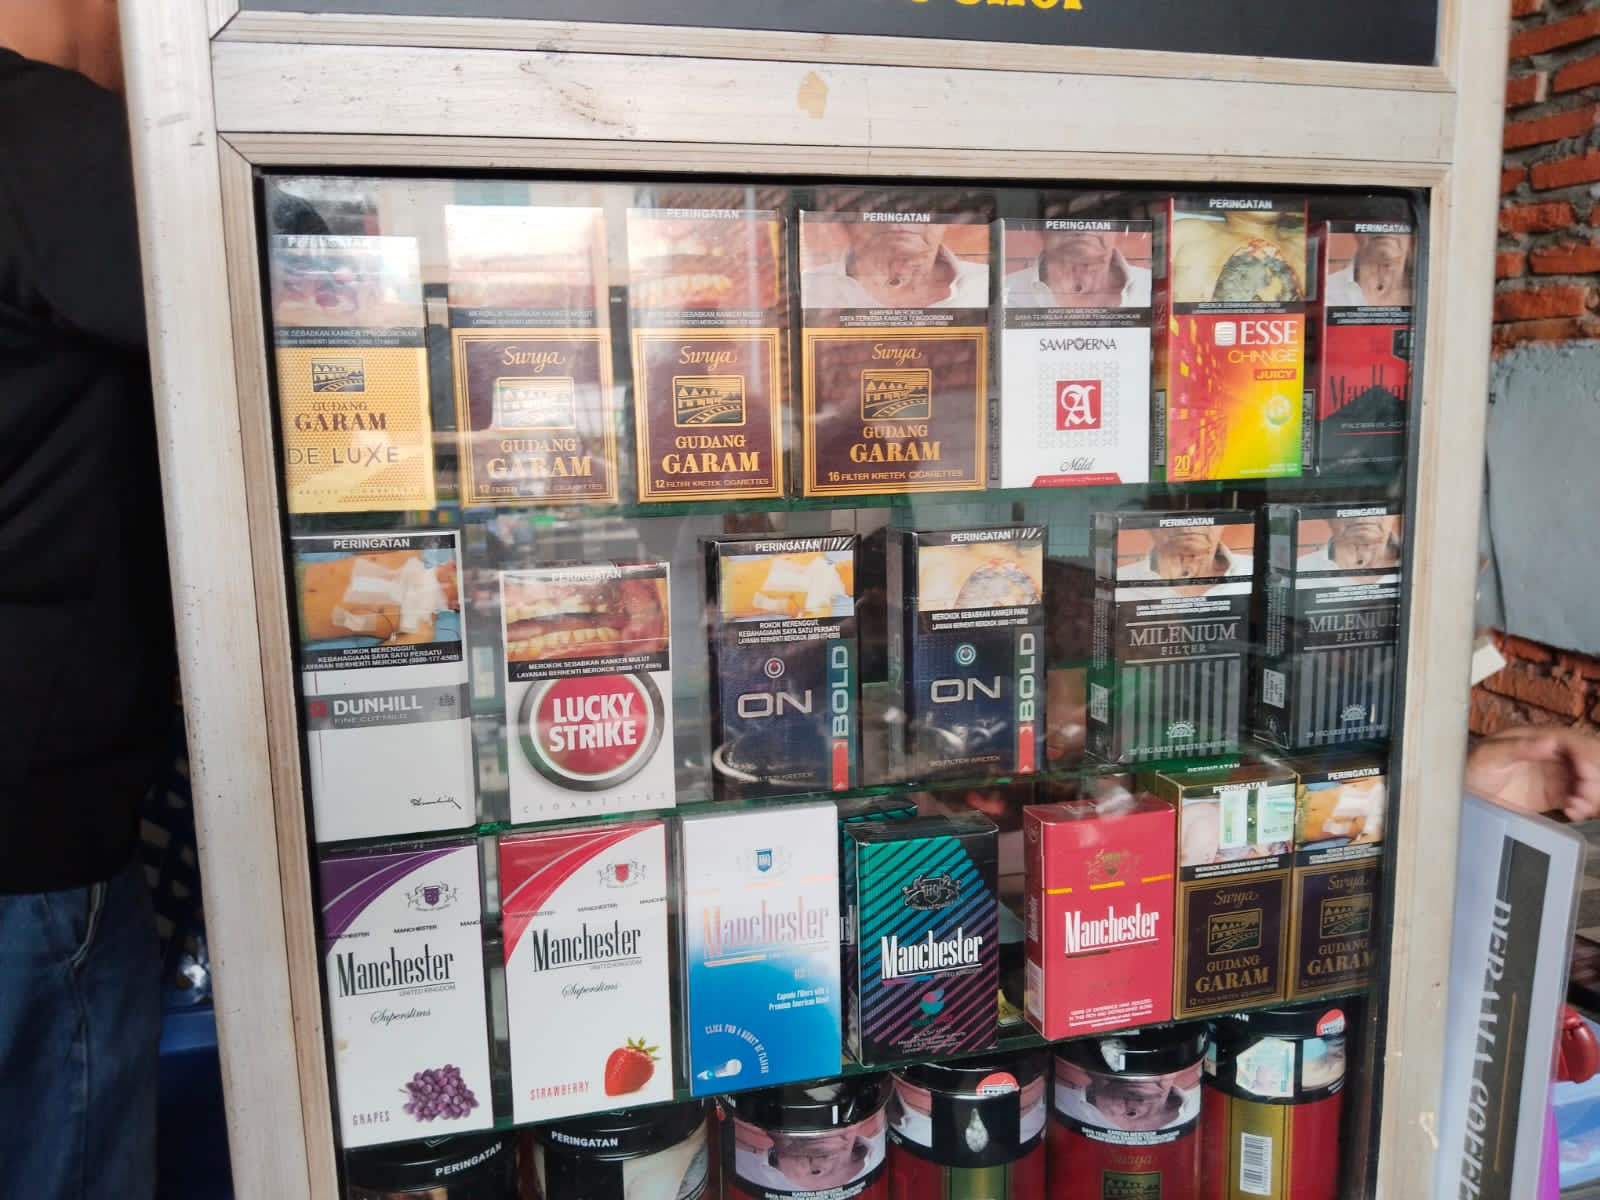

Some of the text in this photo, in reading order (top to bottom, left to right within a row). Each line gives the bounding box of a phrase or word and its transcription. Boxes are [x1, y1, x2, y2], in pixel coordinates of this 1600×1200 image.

[1209, 199, 1272, 209] PERINGATAN
[863, 213, 930, 222] PERINGATAN
[1046, 221, 1110, 231] PERINGATAN
[1240, 320, 1298, 345] ESSE
[1039, 336, 1117, 351] SAMPOERNA
[1228, 349, 1297, 367] CHANGE
[1255, 369, 1294, 380] JUICY
[295, 412, 387, 432] GARAM
[863, 425, 929, 440] GUDANG
[501, 438, 577, 452] GUDANG
[675, 435, 747, 449] GUDANG
[287, 443, 401, 467] DE LUXE
[850, 441, 942, 463] GARAM
[486, 455, 592, 480] GARAM
[662, 451, 760, 474] GARAM
[1060, 456, 1095, 472] Mild
[1174, 455, 1191, 471] 20
[655, 479, 665, 489] 12
[827, 471, 840, 482] 16
[841, 473, 870, 481] FILTER
[871, 471, 906, 480] KRETEK
[1159, 517, 1215, 527] PERINGATAN
[333, 538, 411, 550] PERINGATAN
[951, 530, 1011, 542] PERINGATAN
[755, 541, 820, 552] PERINGATAN
[1308, 610, 1396, 633] MILENIU
[1130, 623, 1239, 647] MILENIUM
[1336, 632, 1379, 642] FILTER
[1161, 645, 1207, 655] FILTER
[1019, 633, 1035, 722] BOLD
[831, 645, 849, 737] BOLD
[931, 675, 1001, 703] ON
[333, 695, 424, 716] DUNHILL
[553, 692, 634, 723] LUCKY
[737, 689, 812, 718] ON
[550, 720, 637, 752] STRIKE
[1328, 768, 1379, 780] PERINGATAN
[1213, 781, 1268, 794] PERINGATAN
[394, 924, 438, 934] MANCHESTER
[704, 896, 829, 960] Manchester
[1064, 902, 1160, 954] Manchester
[532, 920, 641, 973] Manchester
[881, 927, 983, 980] Manchester
[1318, 939, 1368, 956] GUDANG
[336, 943, 455, 998] Manchester
[1206, 954, 1261, 971] GUDANG
[1195, 966, 1270, 993] GARAM
[530, 1080, 590, 1101] STRAWBERRY
[352, 1110, 391, 1126] GRAPES
[551, 1131, 619, 1147] PERINGATAN
[434, 1141, 502, 1177] PERINGATAN
